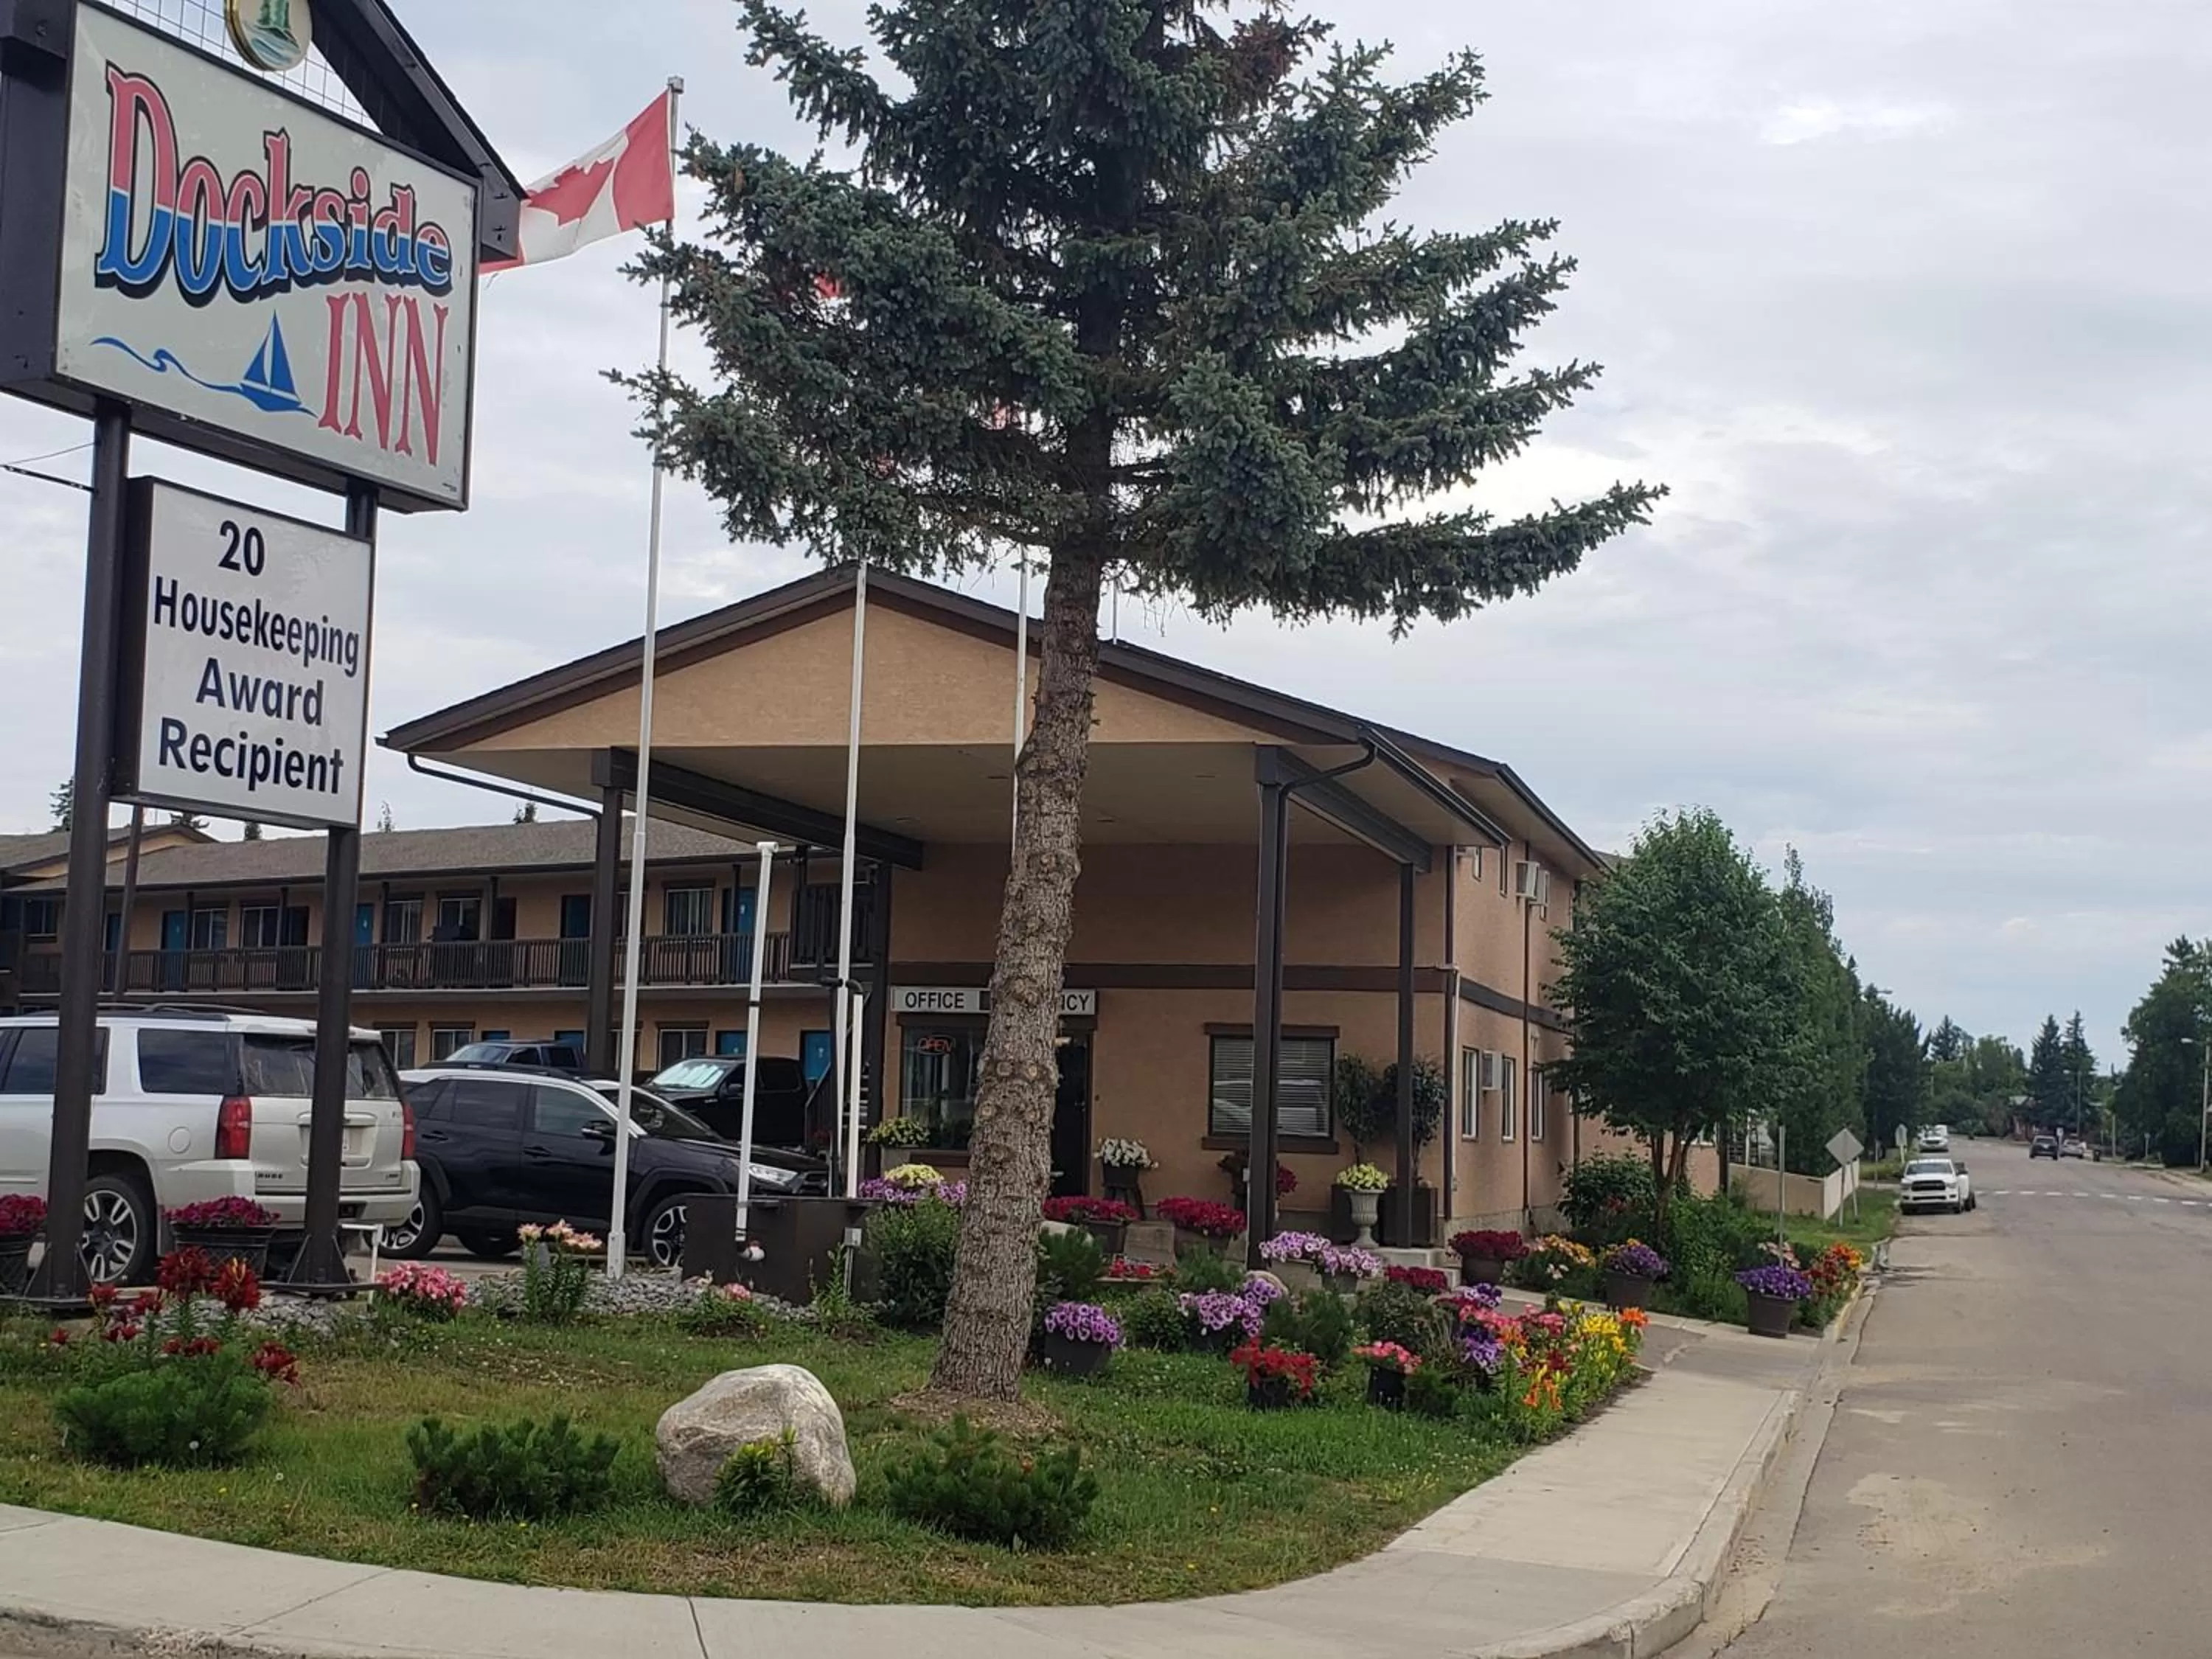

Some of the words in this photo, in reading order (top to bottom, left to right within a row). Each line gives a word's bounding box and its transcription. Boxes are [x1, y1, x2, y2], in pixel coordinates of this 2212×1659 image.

[94, 60, 453, 308] Dockside
[318, 291, 449, 466] INN
[218, 519, 265, 577] 20
[153, 575, 359, 678] Housekeeping
[195, 657, 323, 726] Award
[159, 717, 344, 795] Recipient
[905, 992, 964, 1009] OFFICE
[917, 1036, 951, 1054] OPEN
